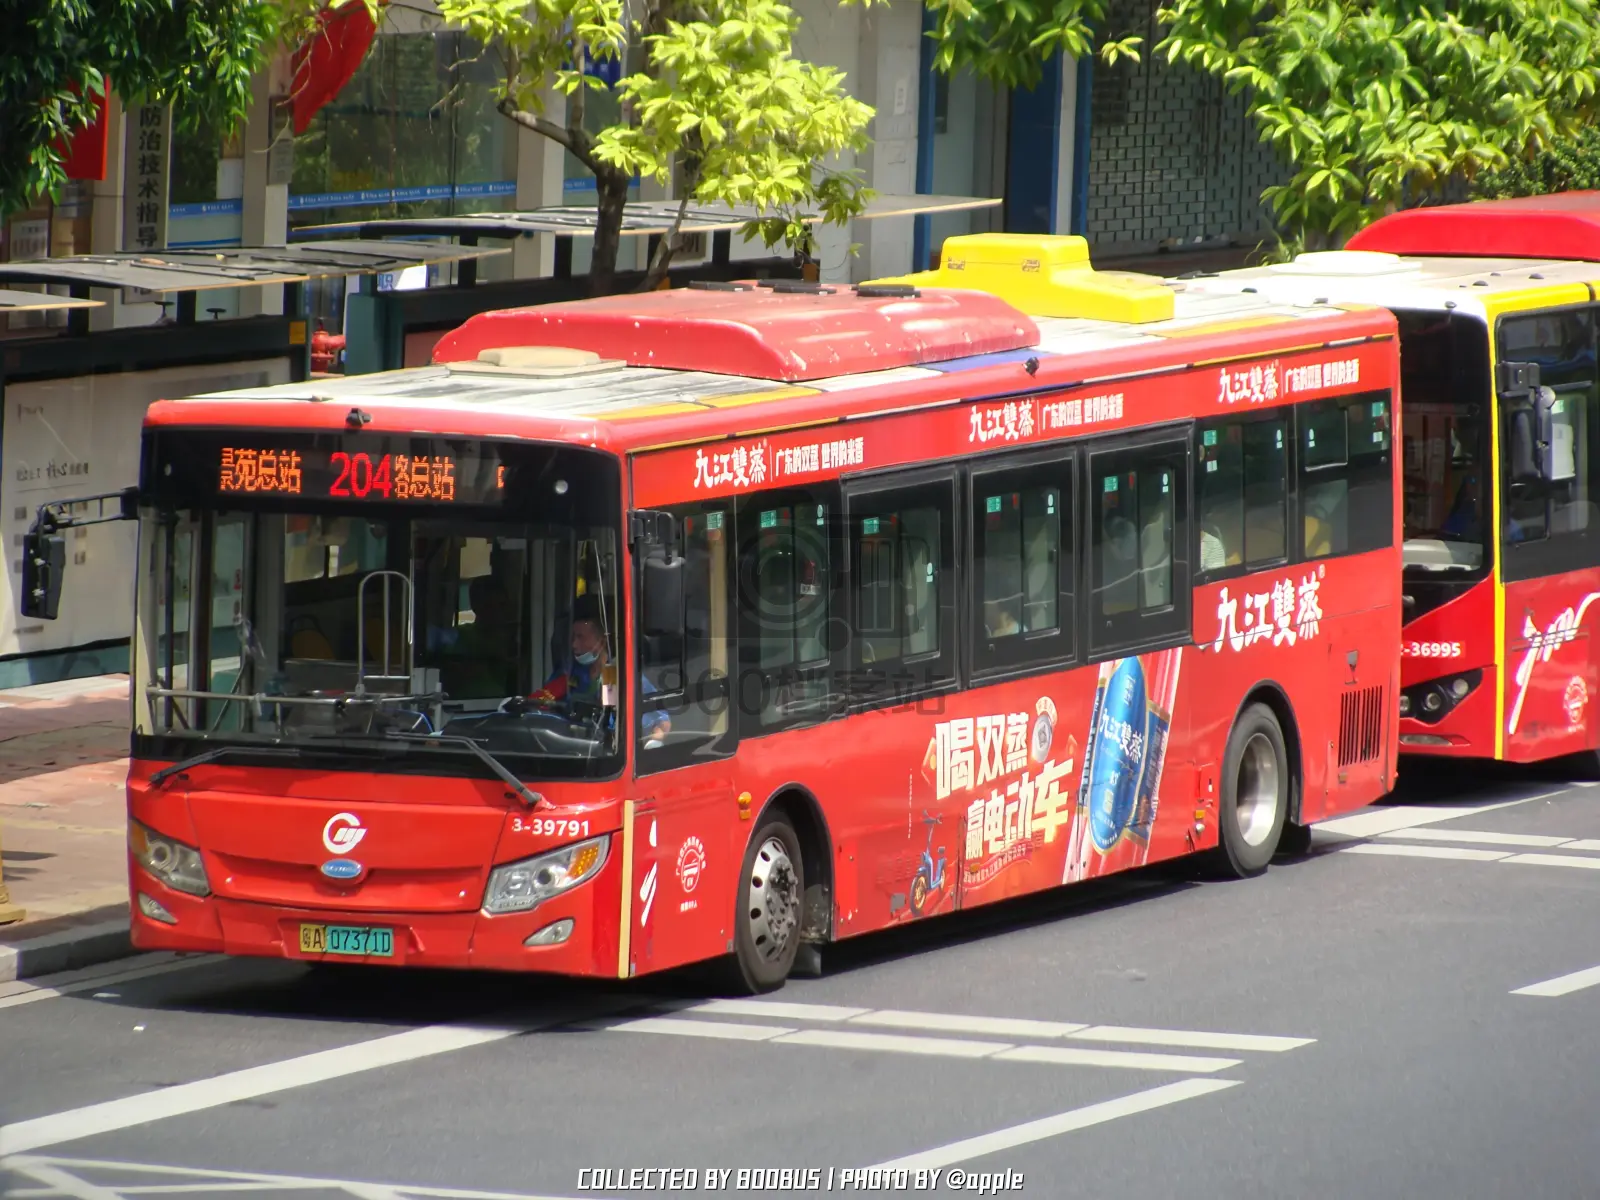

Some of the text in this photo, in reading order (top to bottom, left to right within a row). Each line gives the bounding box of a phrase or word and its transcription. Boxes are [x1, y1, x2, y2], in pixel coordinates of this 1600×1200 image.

[968, 398, 1035, 443] 九江雙蒸
[329, 452, 393, 498] 204
[693, 442, 767, 489] 九江雙蒸
[1214, 571, 1323, 653] 九江雙蒸
[1400, 641, 1462, 658] -36995
[935, 711, 1029, 801] 喝双蒸
[512, 817, 590, 838] 3-39791
[965, 758, 1074, 861] 赢电动车
